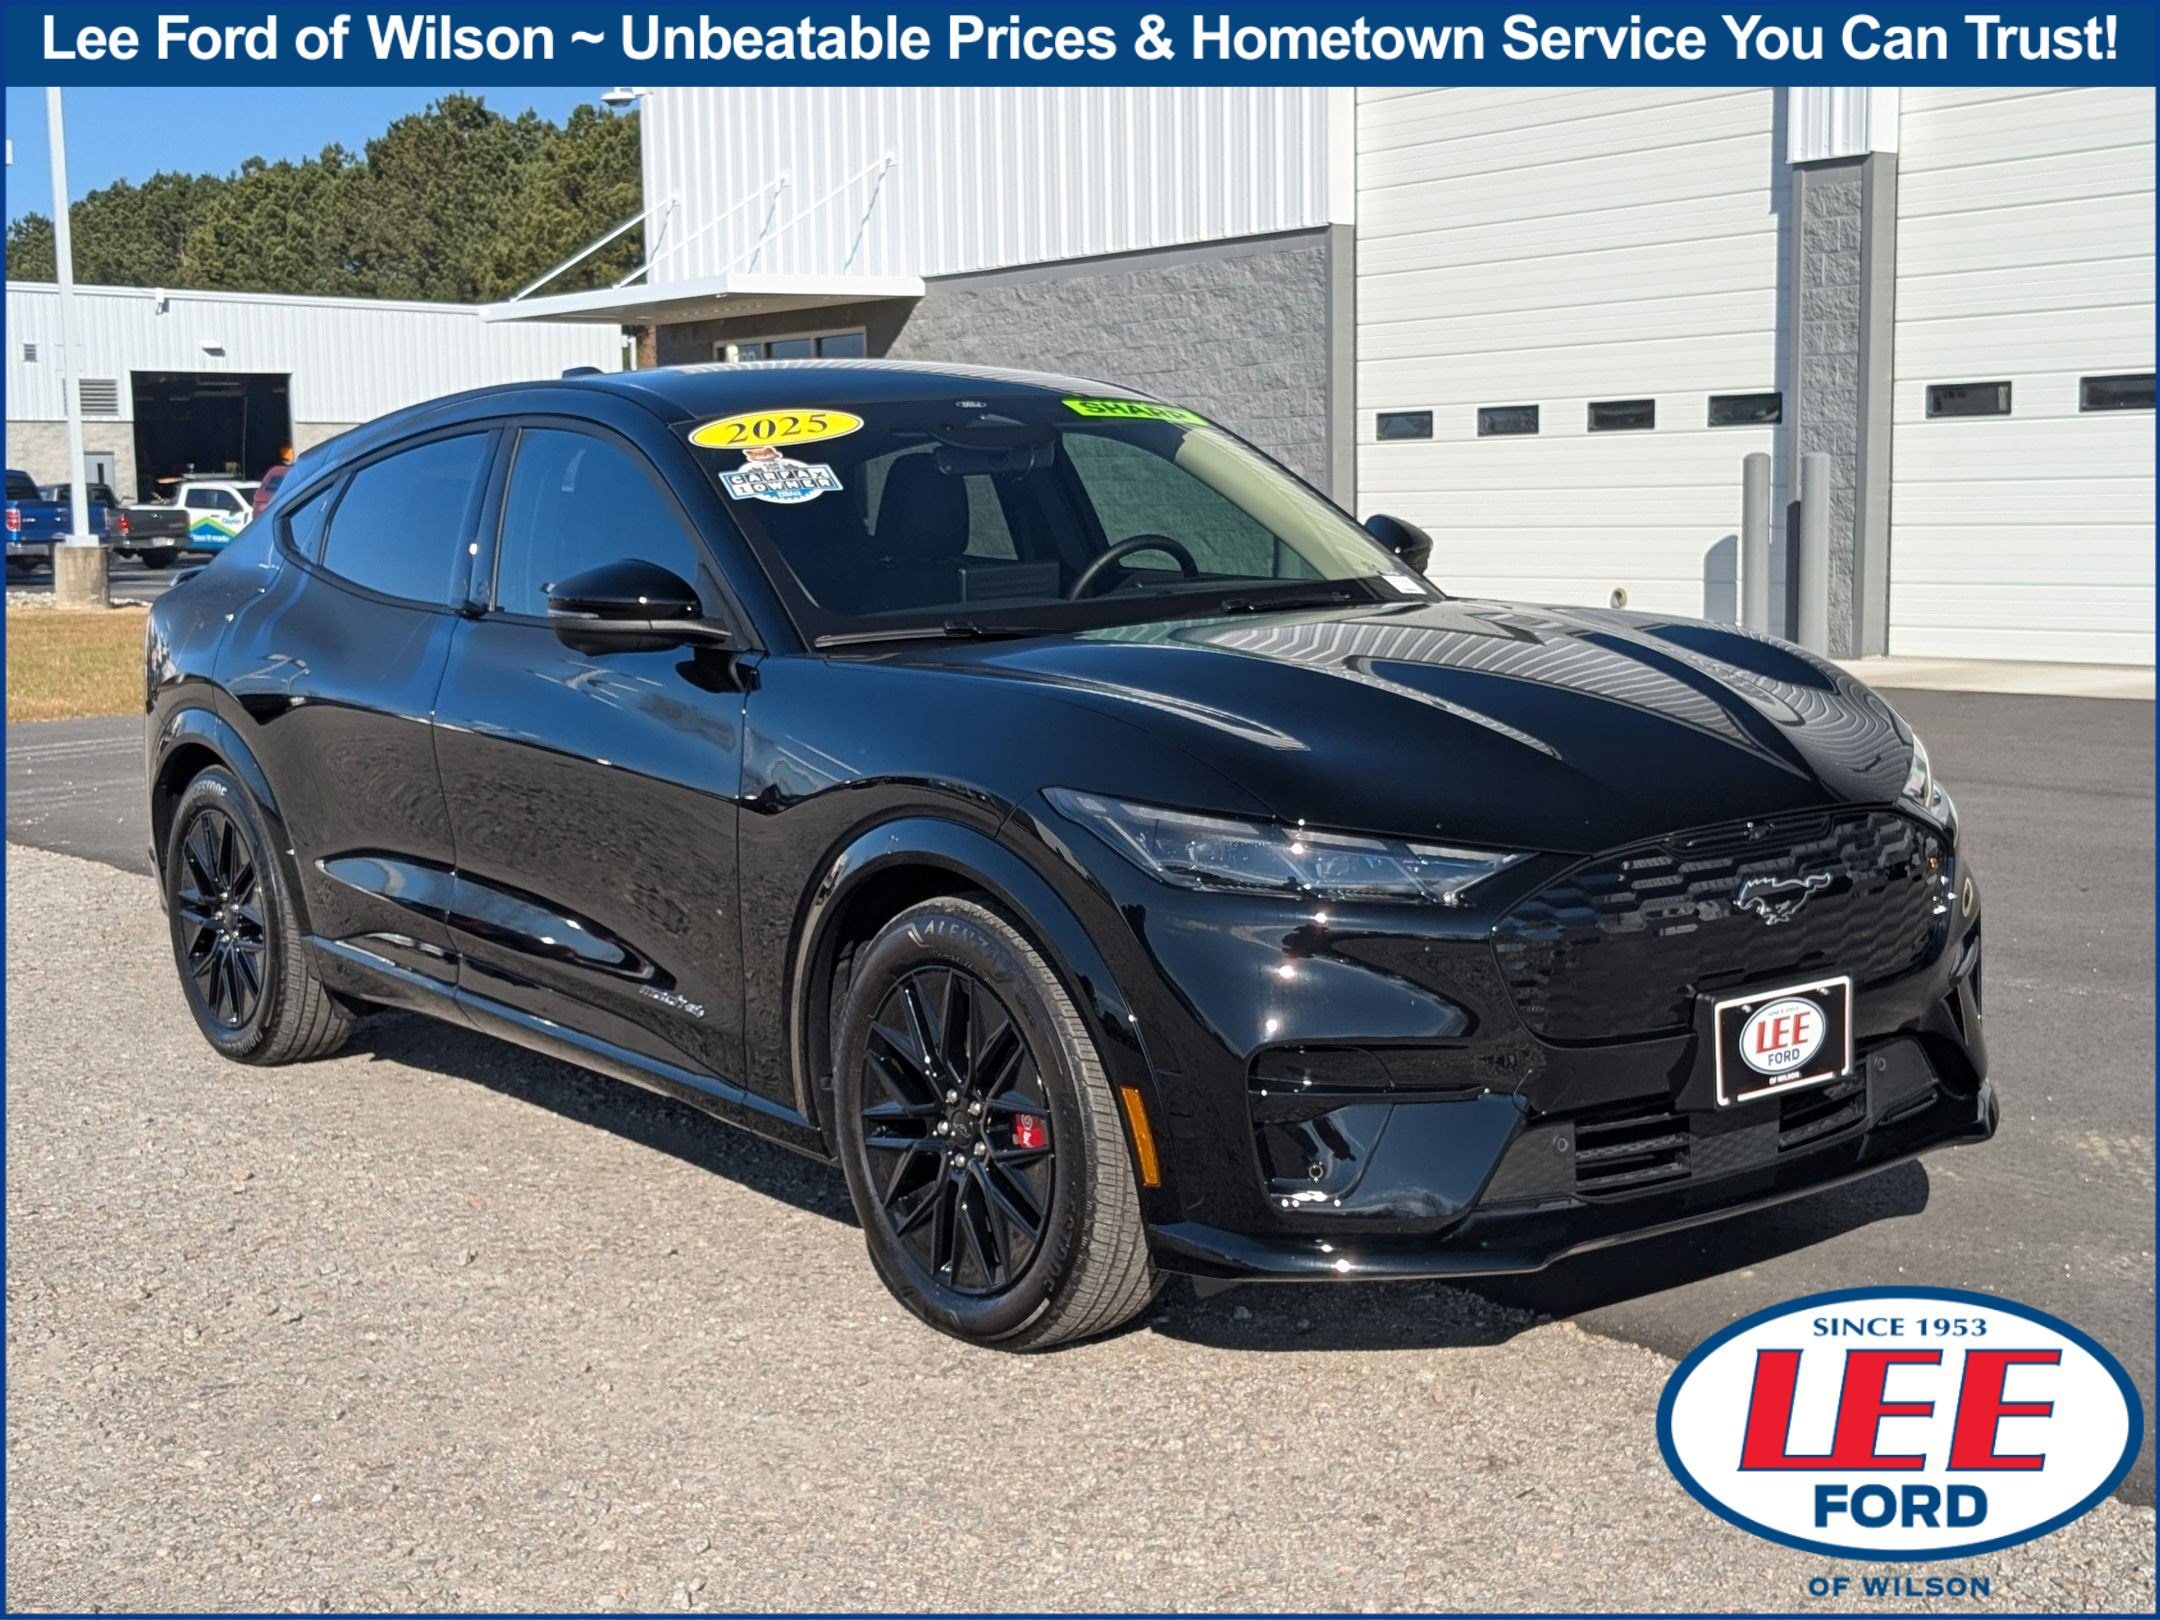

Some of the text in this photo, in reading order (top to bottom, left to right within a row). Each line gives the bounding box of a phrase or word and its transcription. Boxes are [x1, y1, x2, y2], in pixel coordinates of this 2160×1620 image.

[726, 413, 828, 445] 2025
[729, 470, 826, 485] CARFAX
[751, 478, 832, 494] OWNER
[1756, 1010, 1811, 1054] LEE
[1768, 1048, 1800, 1066] FORD
